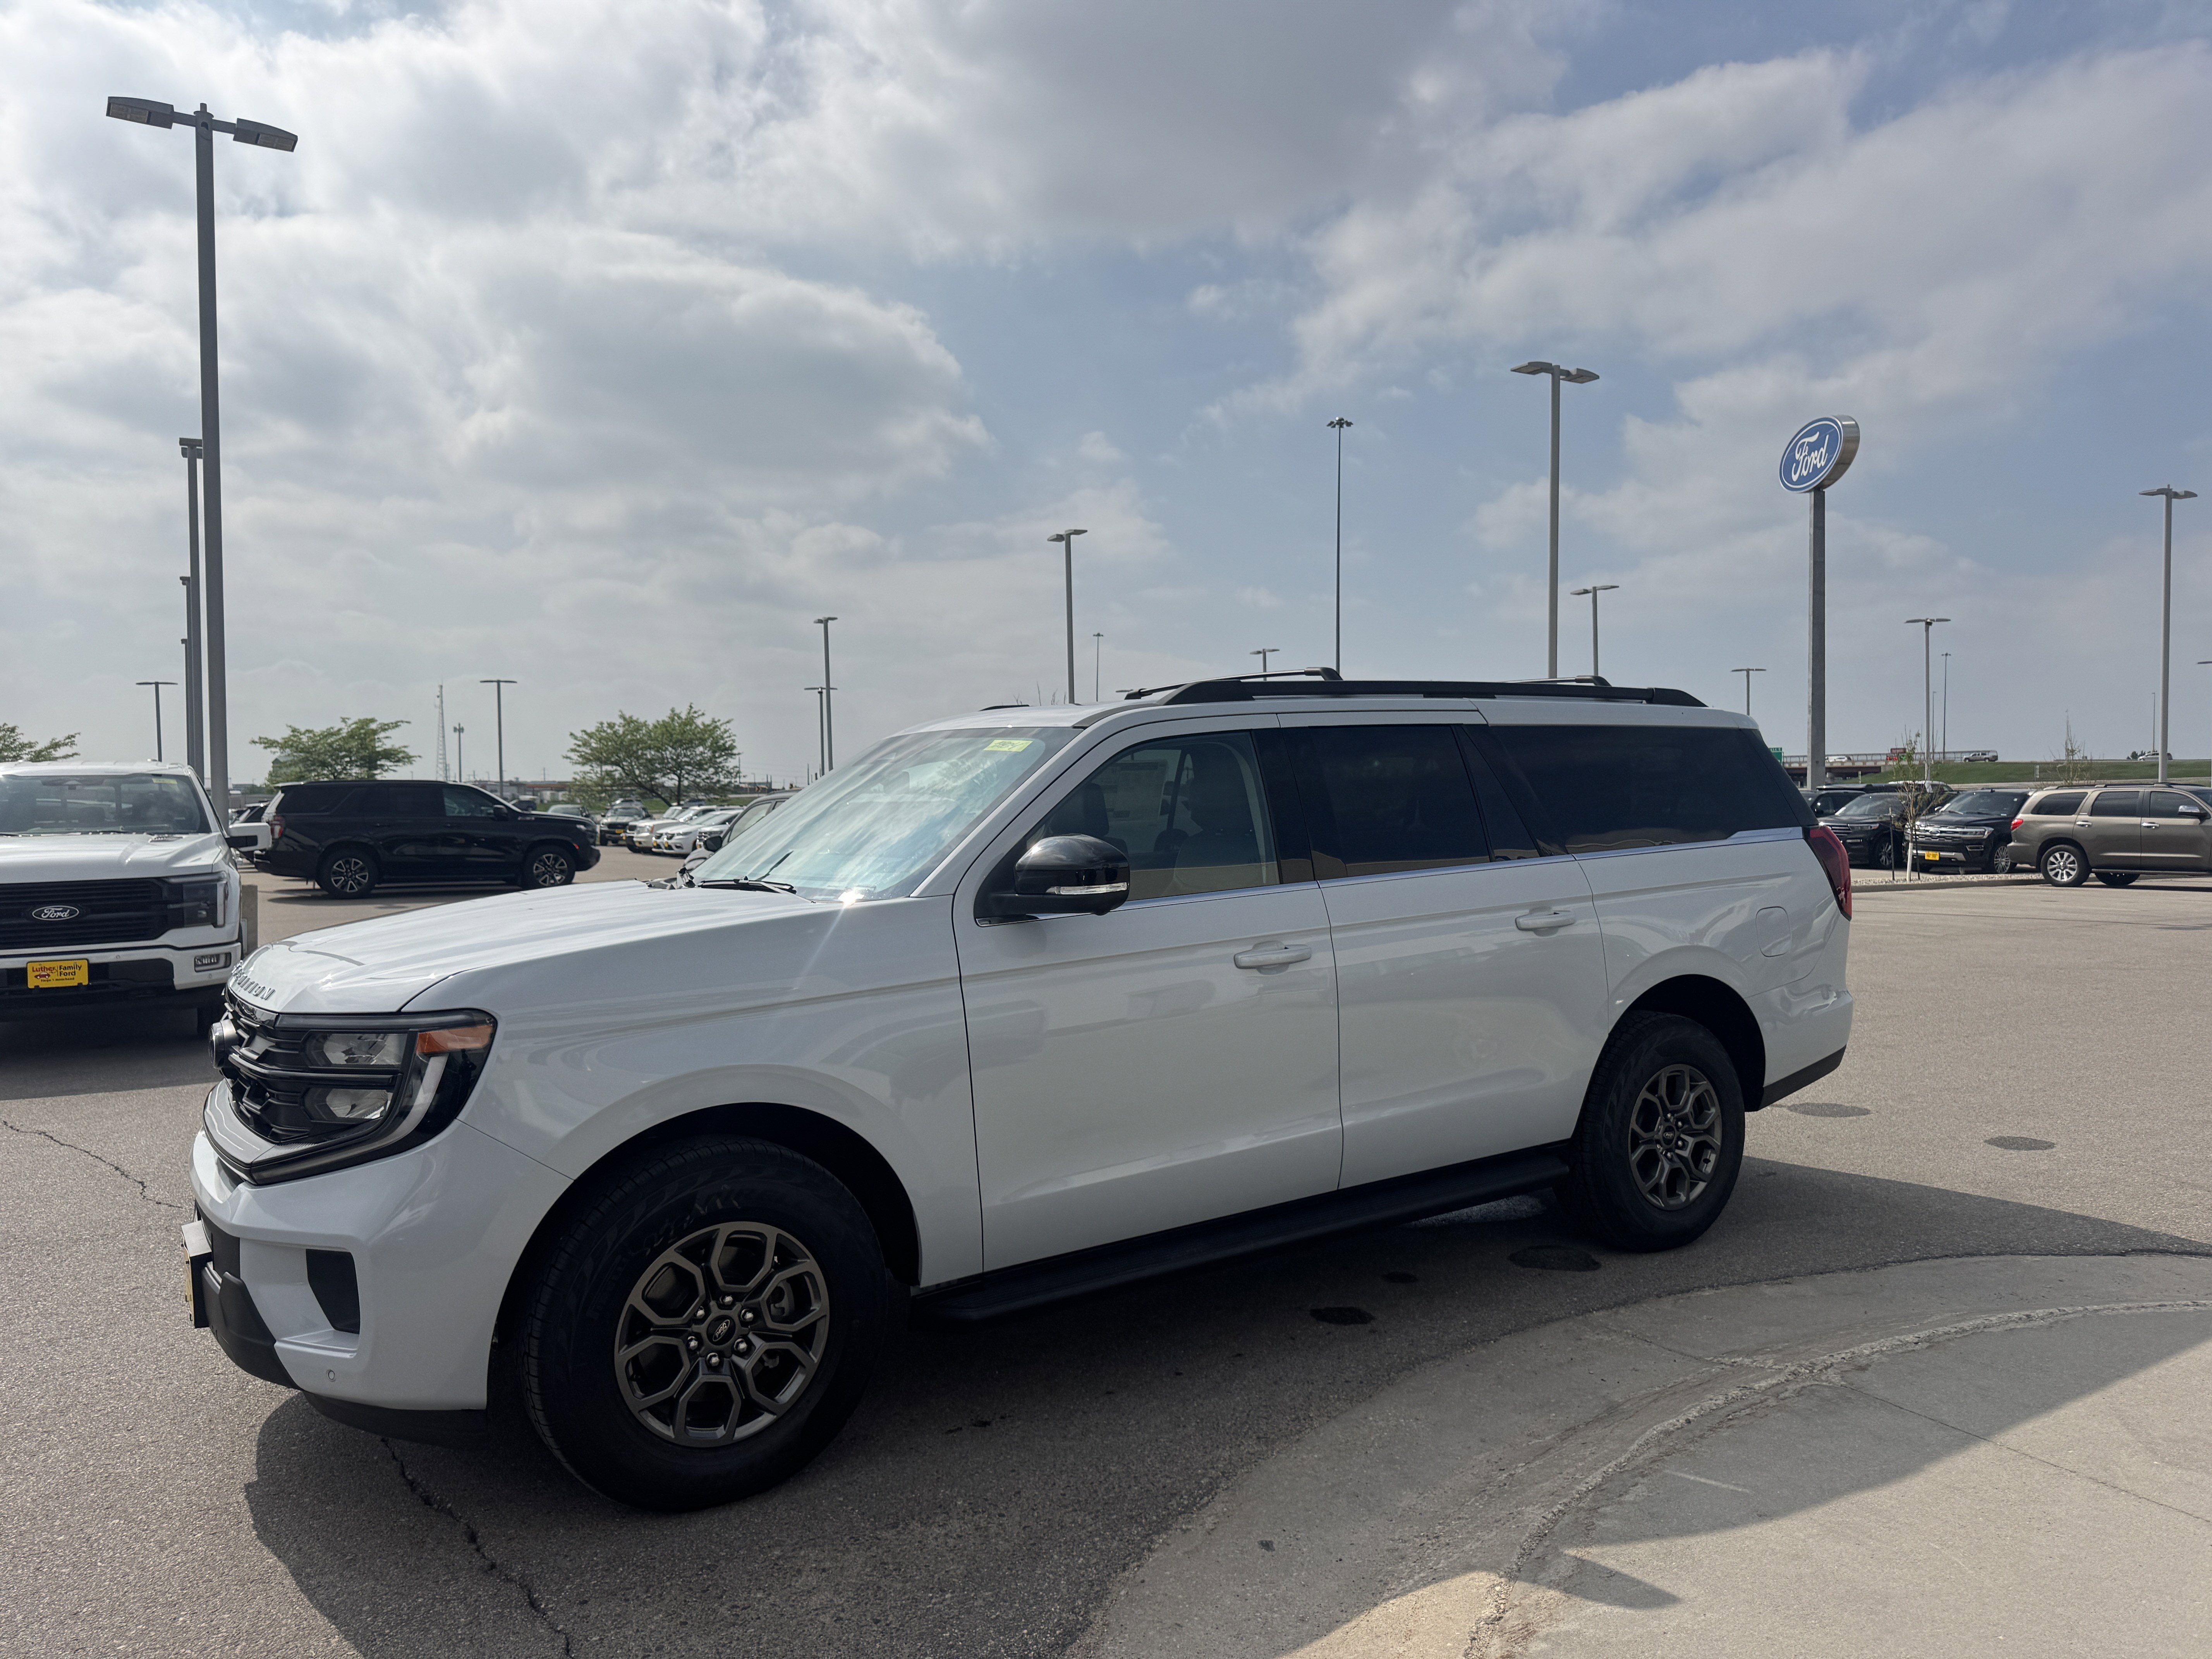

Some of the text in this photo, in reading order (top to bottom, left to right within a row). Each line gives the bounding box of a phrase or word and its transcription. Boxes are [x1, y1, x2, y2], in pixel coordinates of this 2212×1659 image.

[1791, 431, 1829, 481] Ford
[41, 908, 70, 918] Ford
[715, 1322, 727, 1338] Ford
